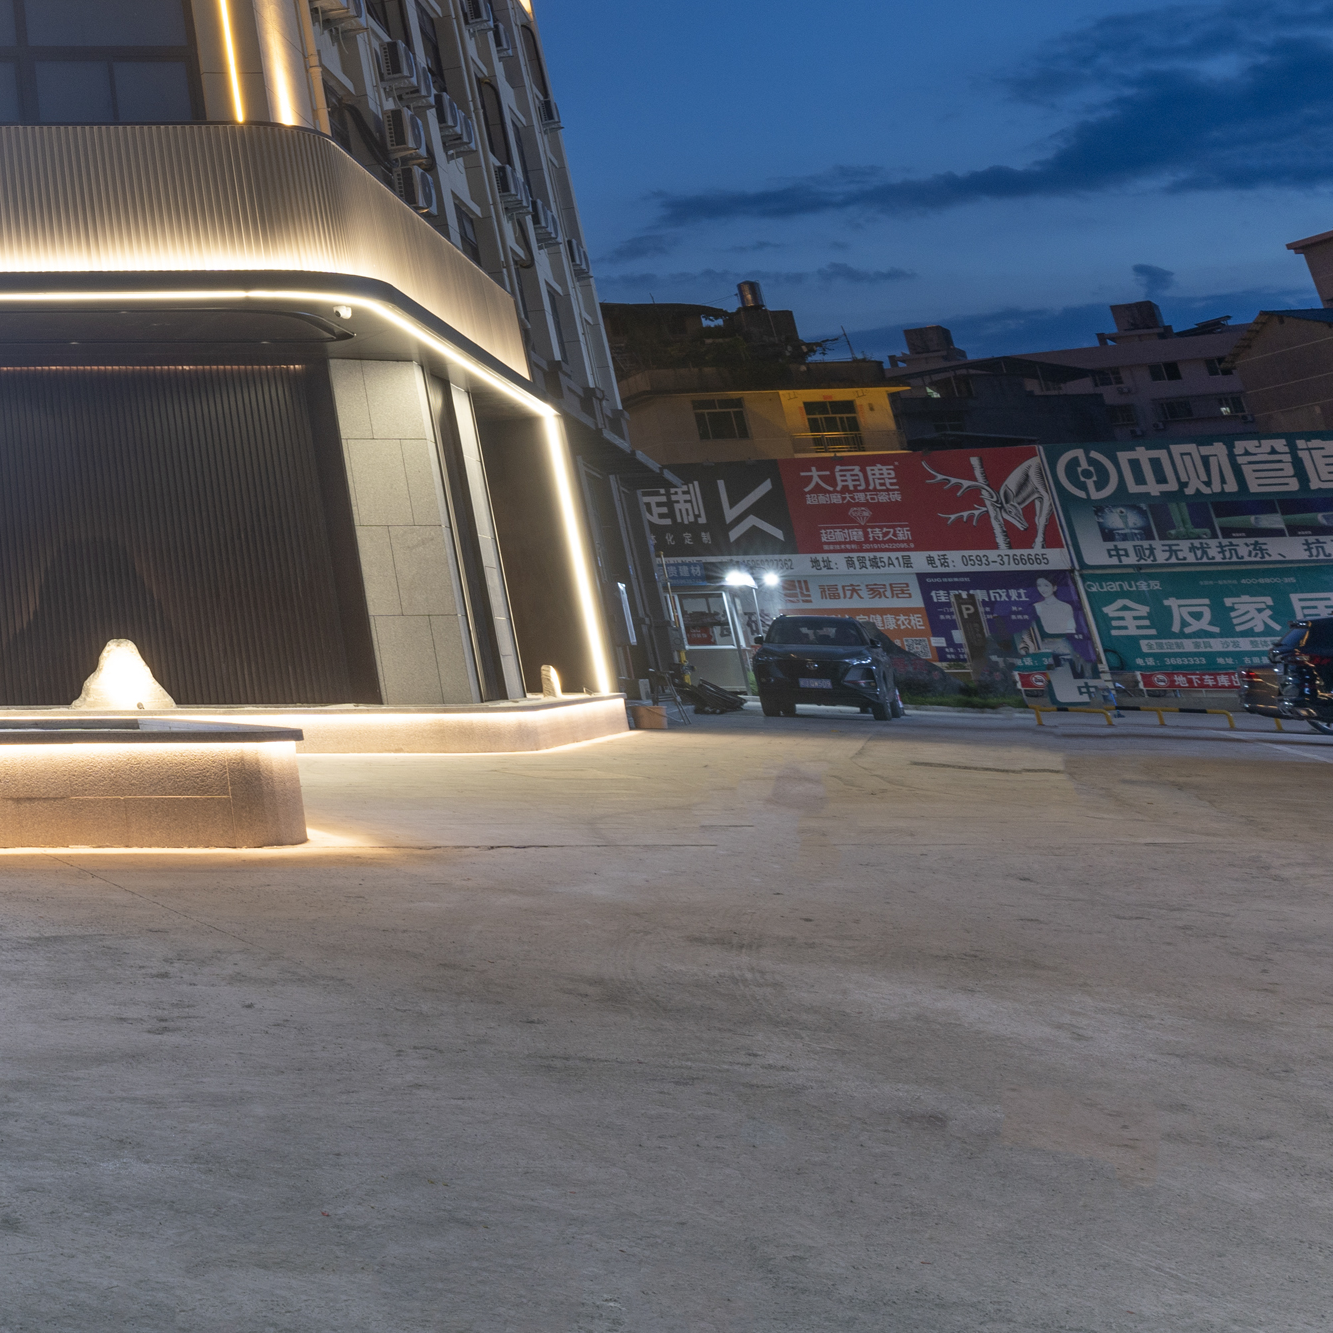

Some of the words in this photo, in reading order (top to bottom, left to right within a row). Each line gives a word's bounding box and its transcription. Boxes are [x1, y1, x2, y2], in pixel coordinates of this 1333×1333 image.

[800, 464, 900, 492] 大角鹿
[805, 491, 902, 505] 超耐磨大理石瓷砖
[820, 528, 865, 542] 超耐磨
[867, 527, 913, 541] 持久新
[818, 582, 912, 600] 福庆家居
[960, 604, 975, 619] P
[1192, 641, 1213, 650] 家具
[1220, 640, 1242, 649] 沙发
